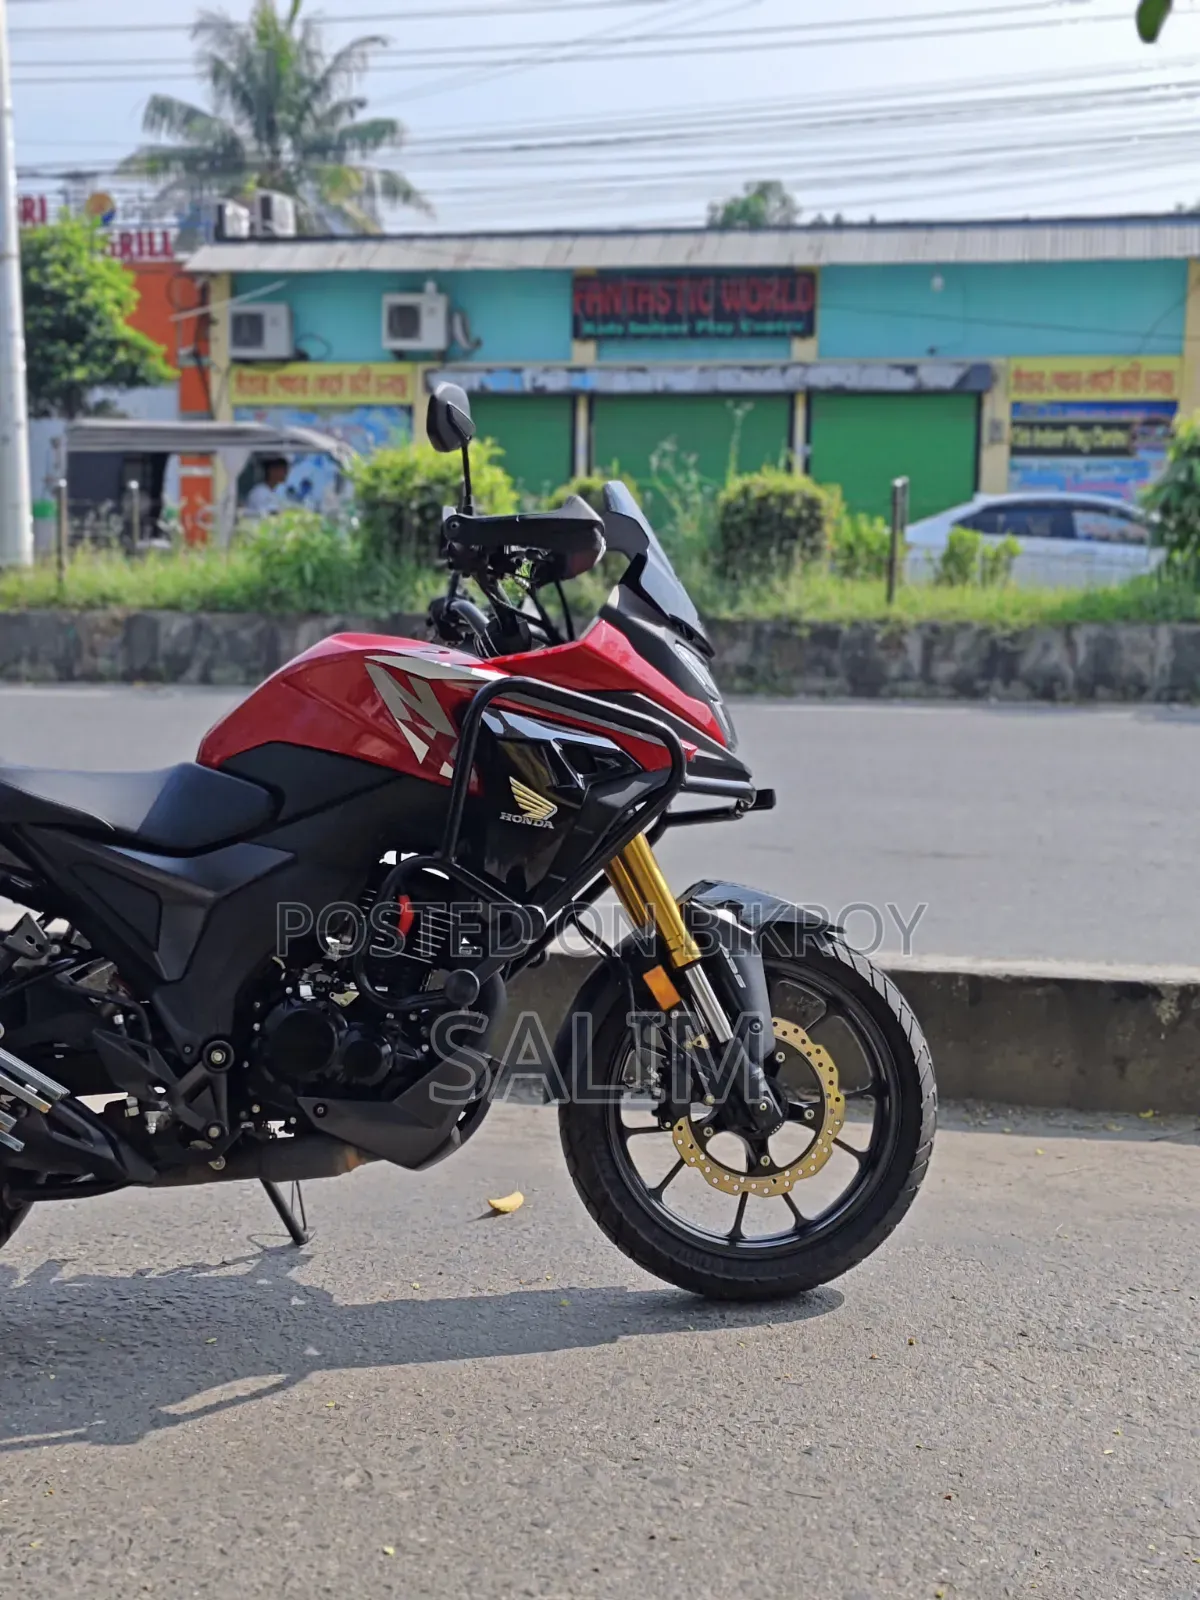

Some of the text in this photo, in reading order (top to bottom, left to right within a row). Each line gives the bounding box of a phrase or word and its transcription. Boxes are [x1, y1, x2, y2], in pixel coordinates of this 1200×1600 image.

[573, 274, 814, 316] FANTASTIC WORLD
[499, 811, 555, 830] HONDA
